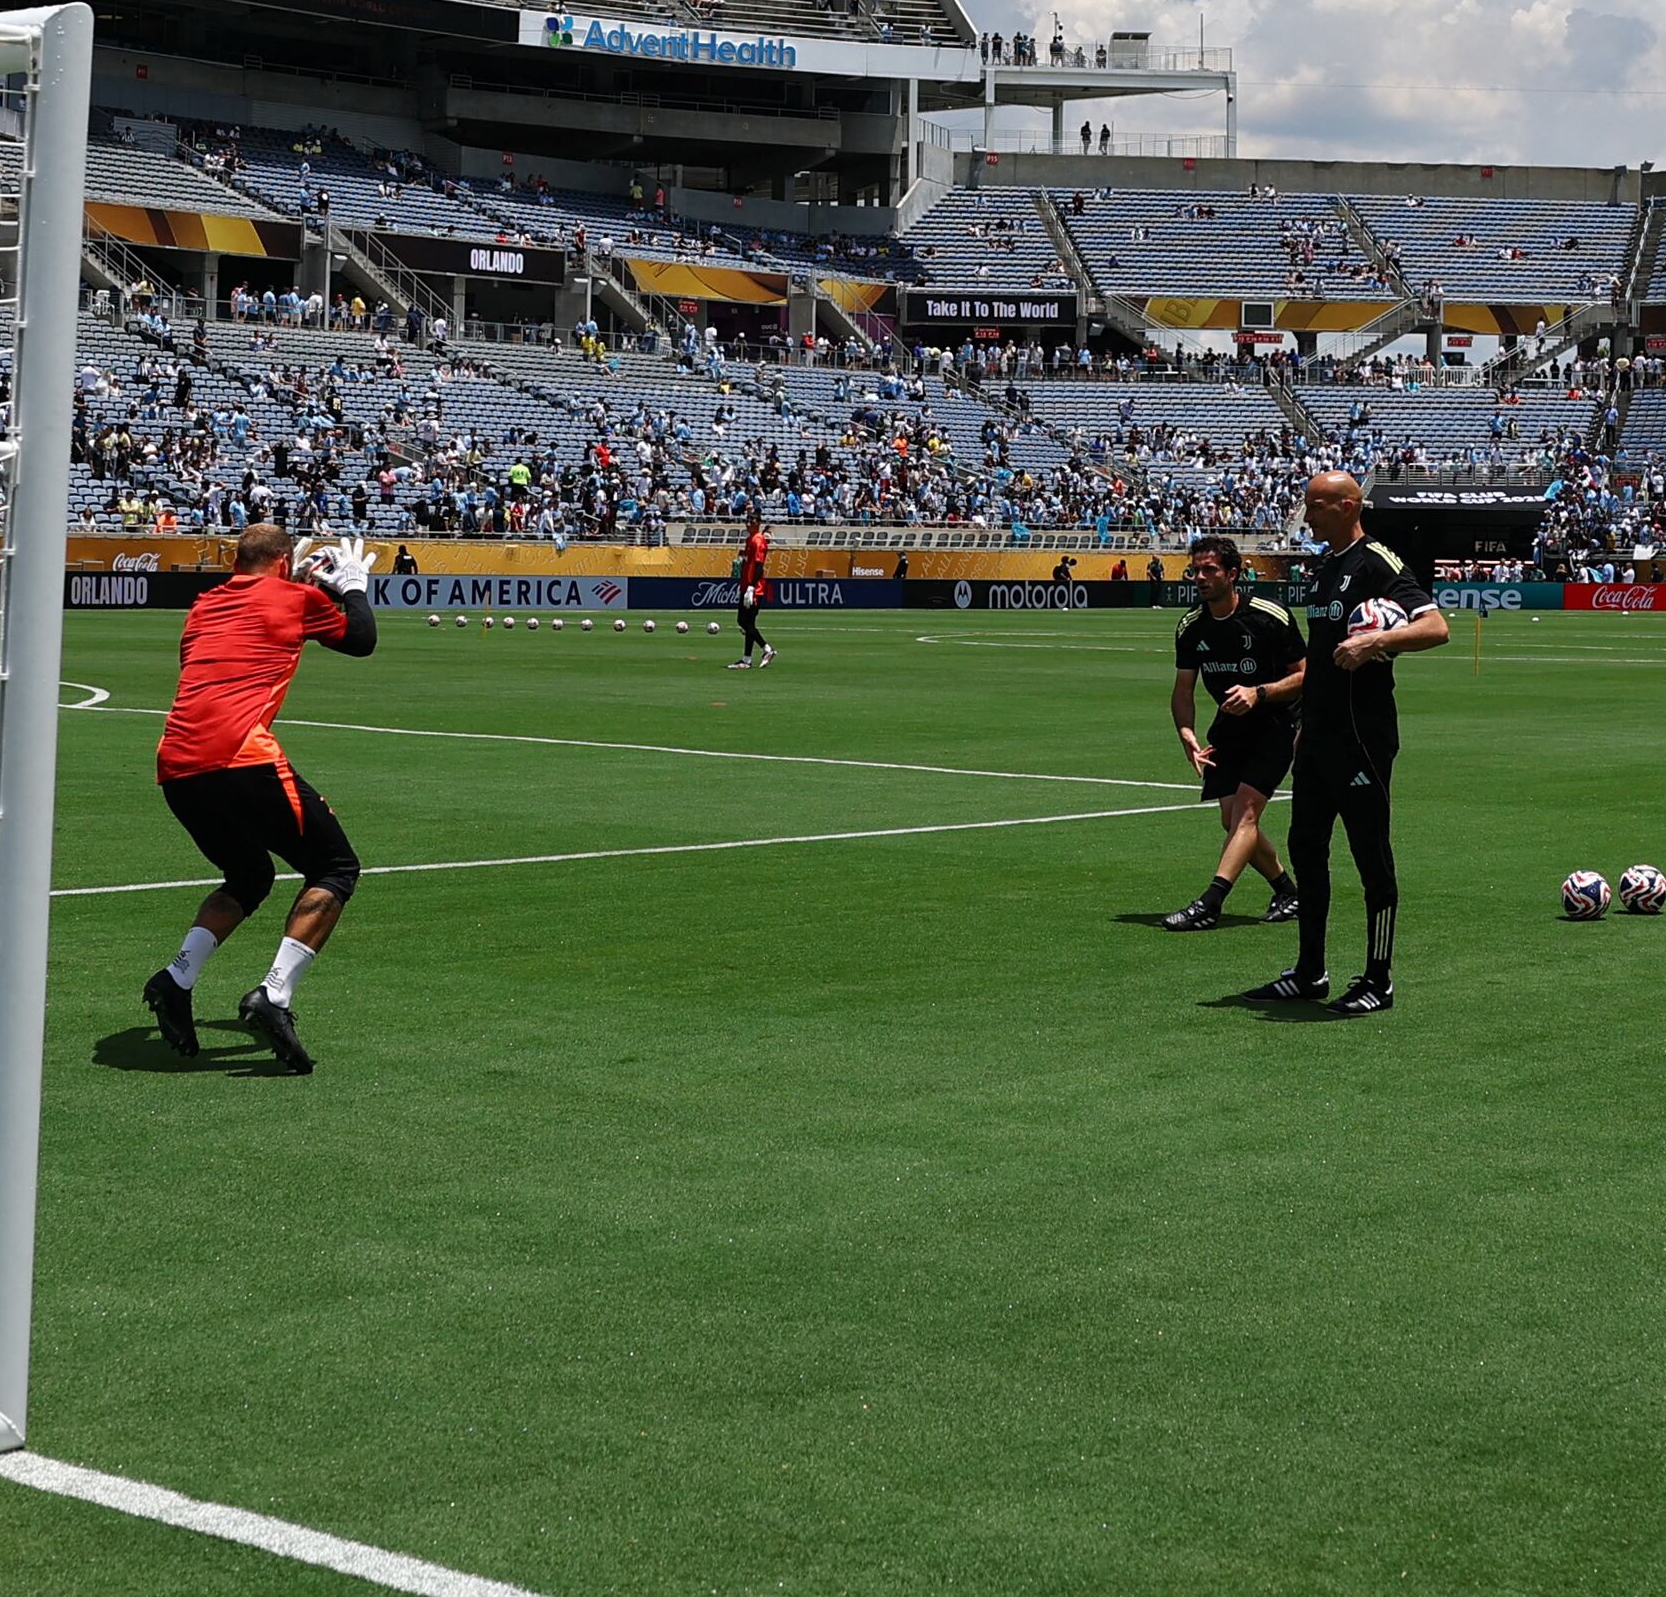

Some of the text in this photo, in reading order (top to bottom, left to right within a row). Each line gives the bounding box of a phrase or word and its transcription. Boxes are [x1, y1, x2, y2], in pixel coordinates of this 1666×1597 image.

[583, 20, 797, 68] AdventHealth
[470, 248, 524, 274] ORLANDO
[926, 300, 1059, 319] Take It To The World
[1388, 496, 1457, 504] WORLD
[1459, 496, 1497, 504] CUP
[1474, 540, 1507, 553] FIFA
[852, 566, 884, 577] Hisense
[70, 576, 148, 605] ORLANDO
[401, 578, 440, 606] OF
[452, 578, 582, 606] AMERICA
[691, 581, 844, 607] Mich ULTRA
[988, 580, 1088, 609] motorola
[1177, 585, 1199, 604] PIF
[1288, 586, 1307, 603] PIF
[1432, 588, 1523, 610] ense
[1591, 585, 1659, 610] Coca-Cola
[1202, 661, 1238, 673] Allianz
